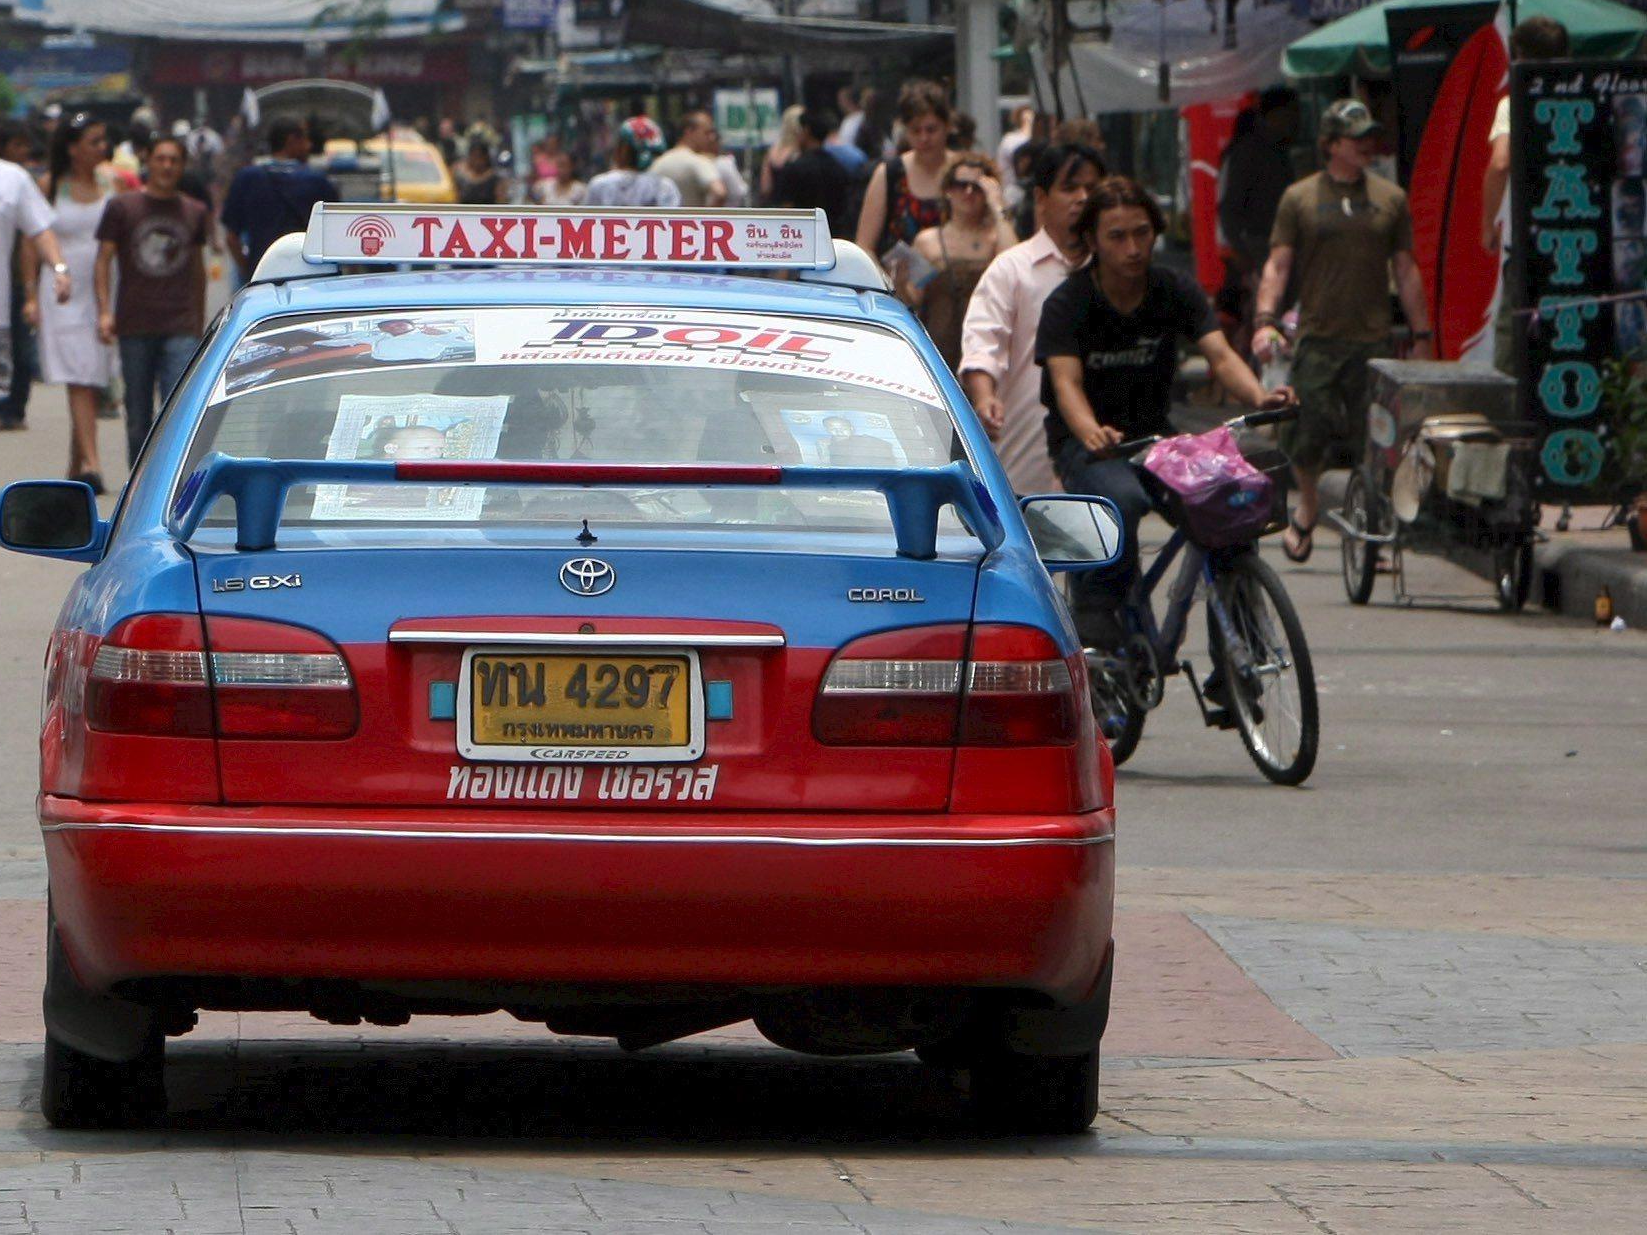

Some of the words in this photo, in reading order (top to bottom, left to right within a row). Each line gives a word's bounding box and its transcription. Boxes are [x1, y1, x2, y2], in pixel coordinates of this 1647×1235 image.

[411, 216, 741, 262] TAXI-METER
[564, 661, 680, 709] 4297
[541, 748, 630, 760] CARSPEED
